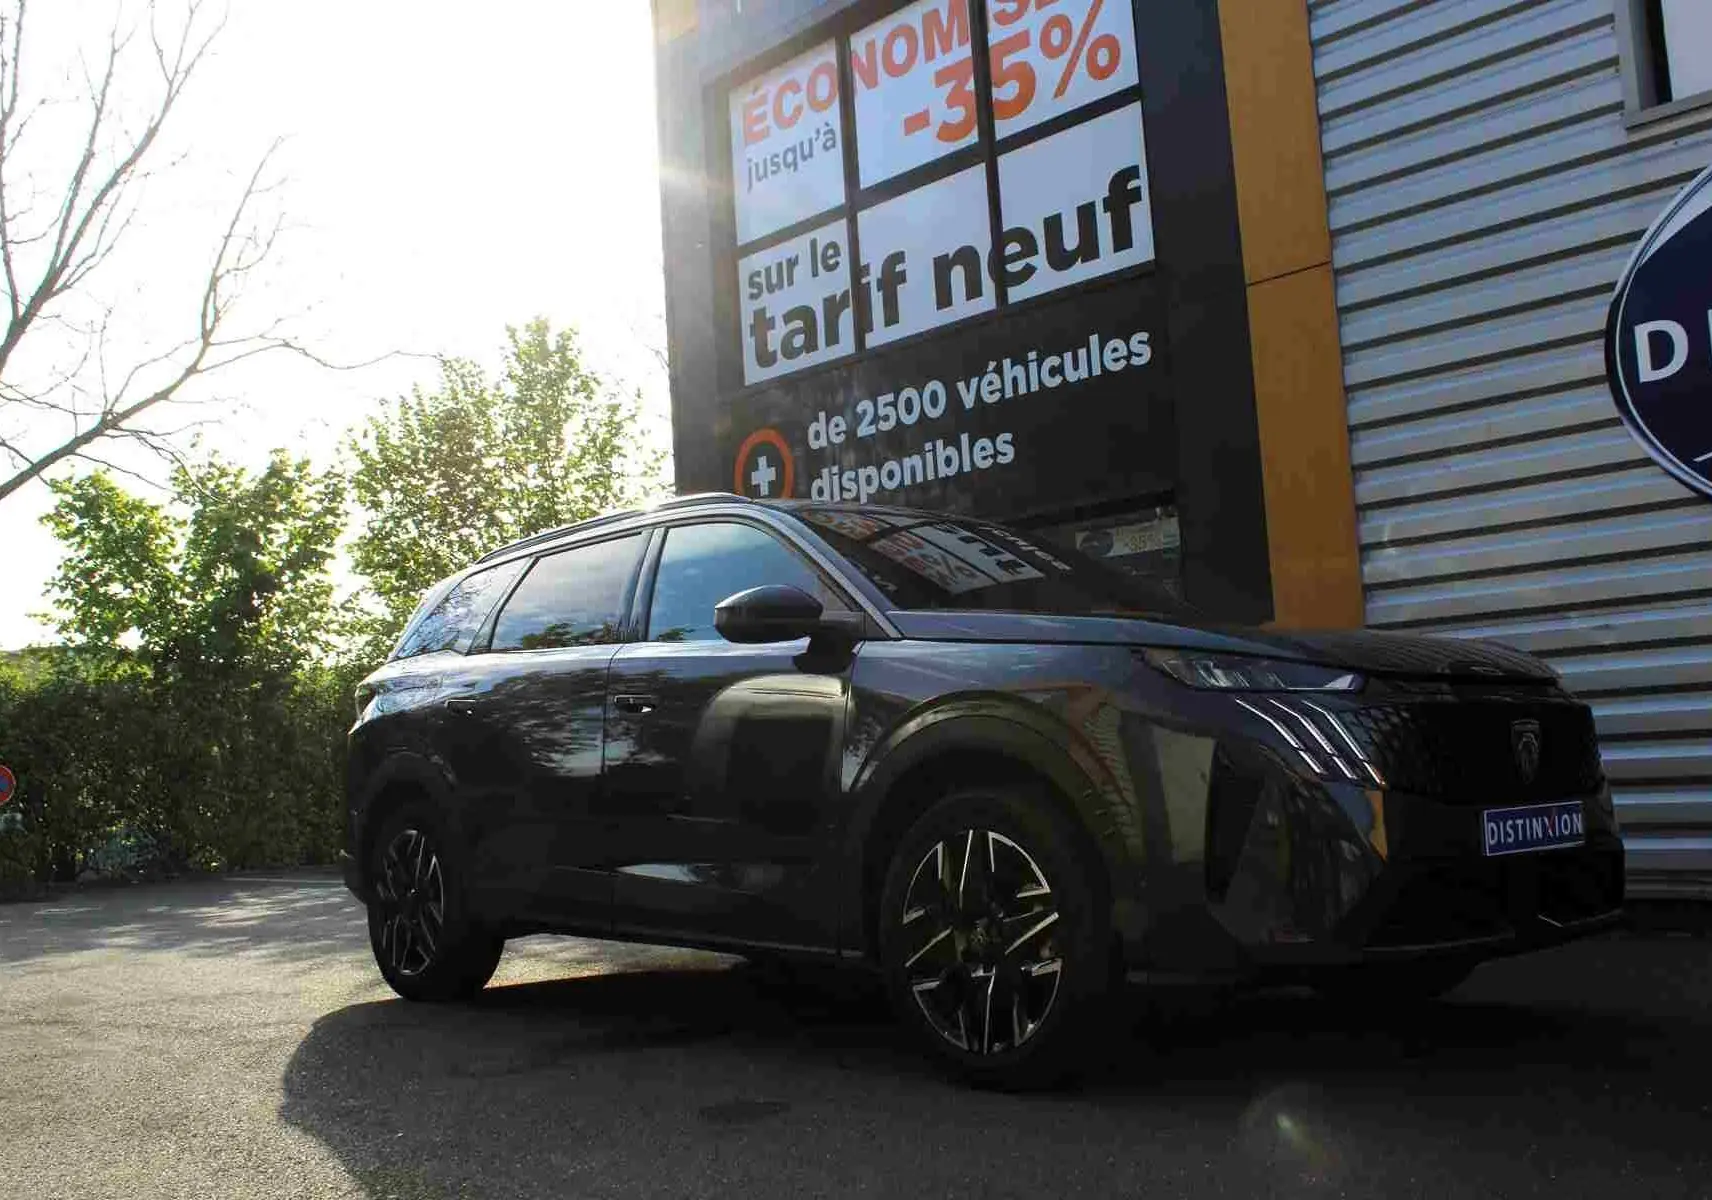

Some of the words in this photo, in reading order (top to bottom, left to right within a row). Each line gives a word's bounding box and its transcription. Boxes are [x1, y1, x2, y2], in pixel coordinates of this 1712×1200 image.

[747, 121, 838, 191] jusqu'à
[903, 0, 1121, 144] -35%
[748, 254, 799, 301] sur
[810, 236, 842, 279] le
[749, 250, 908, 369] tarif
[933, 164, 1142, 311] neuf
[807, 410, 846, 450] de
[856, 380, 946, 438] 2500
[957, 330, 1152, 410] véhicules
[811, 432, 1016, 504] disponibles
[1487, 811, 1584, 845] DISTINXION
